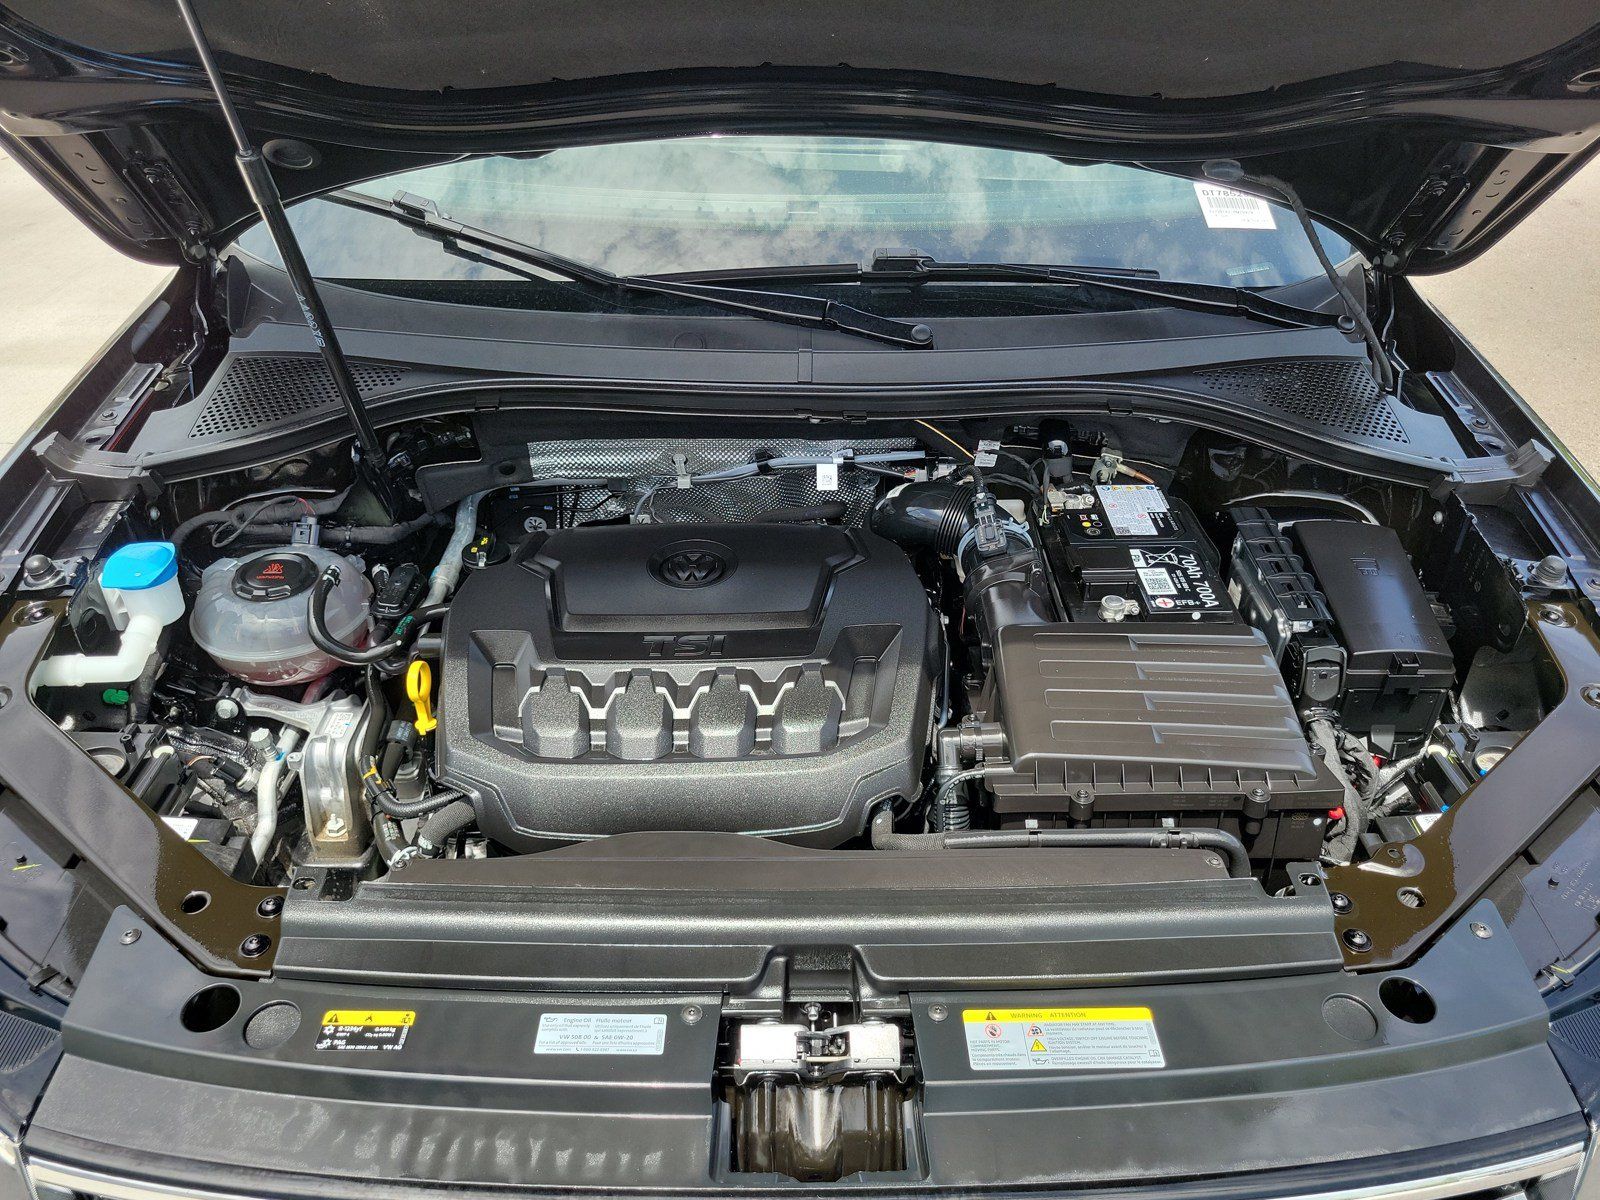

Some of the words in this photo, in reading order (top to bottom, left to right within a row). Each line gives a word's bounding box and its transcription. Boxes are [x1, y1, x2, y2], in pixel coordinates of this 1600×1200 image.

[1179, 554, 1203, 578] 70Ah
[1192, 580, 1220, 608] 700A
[642, 634, 727, 656] TSI
